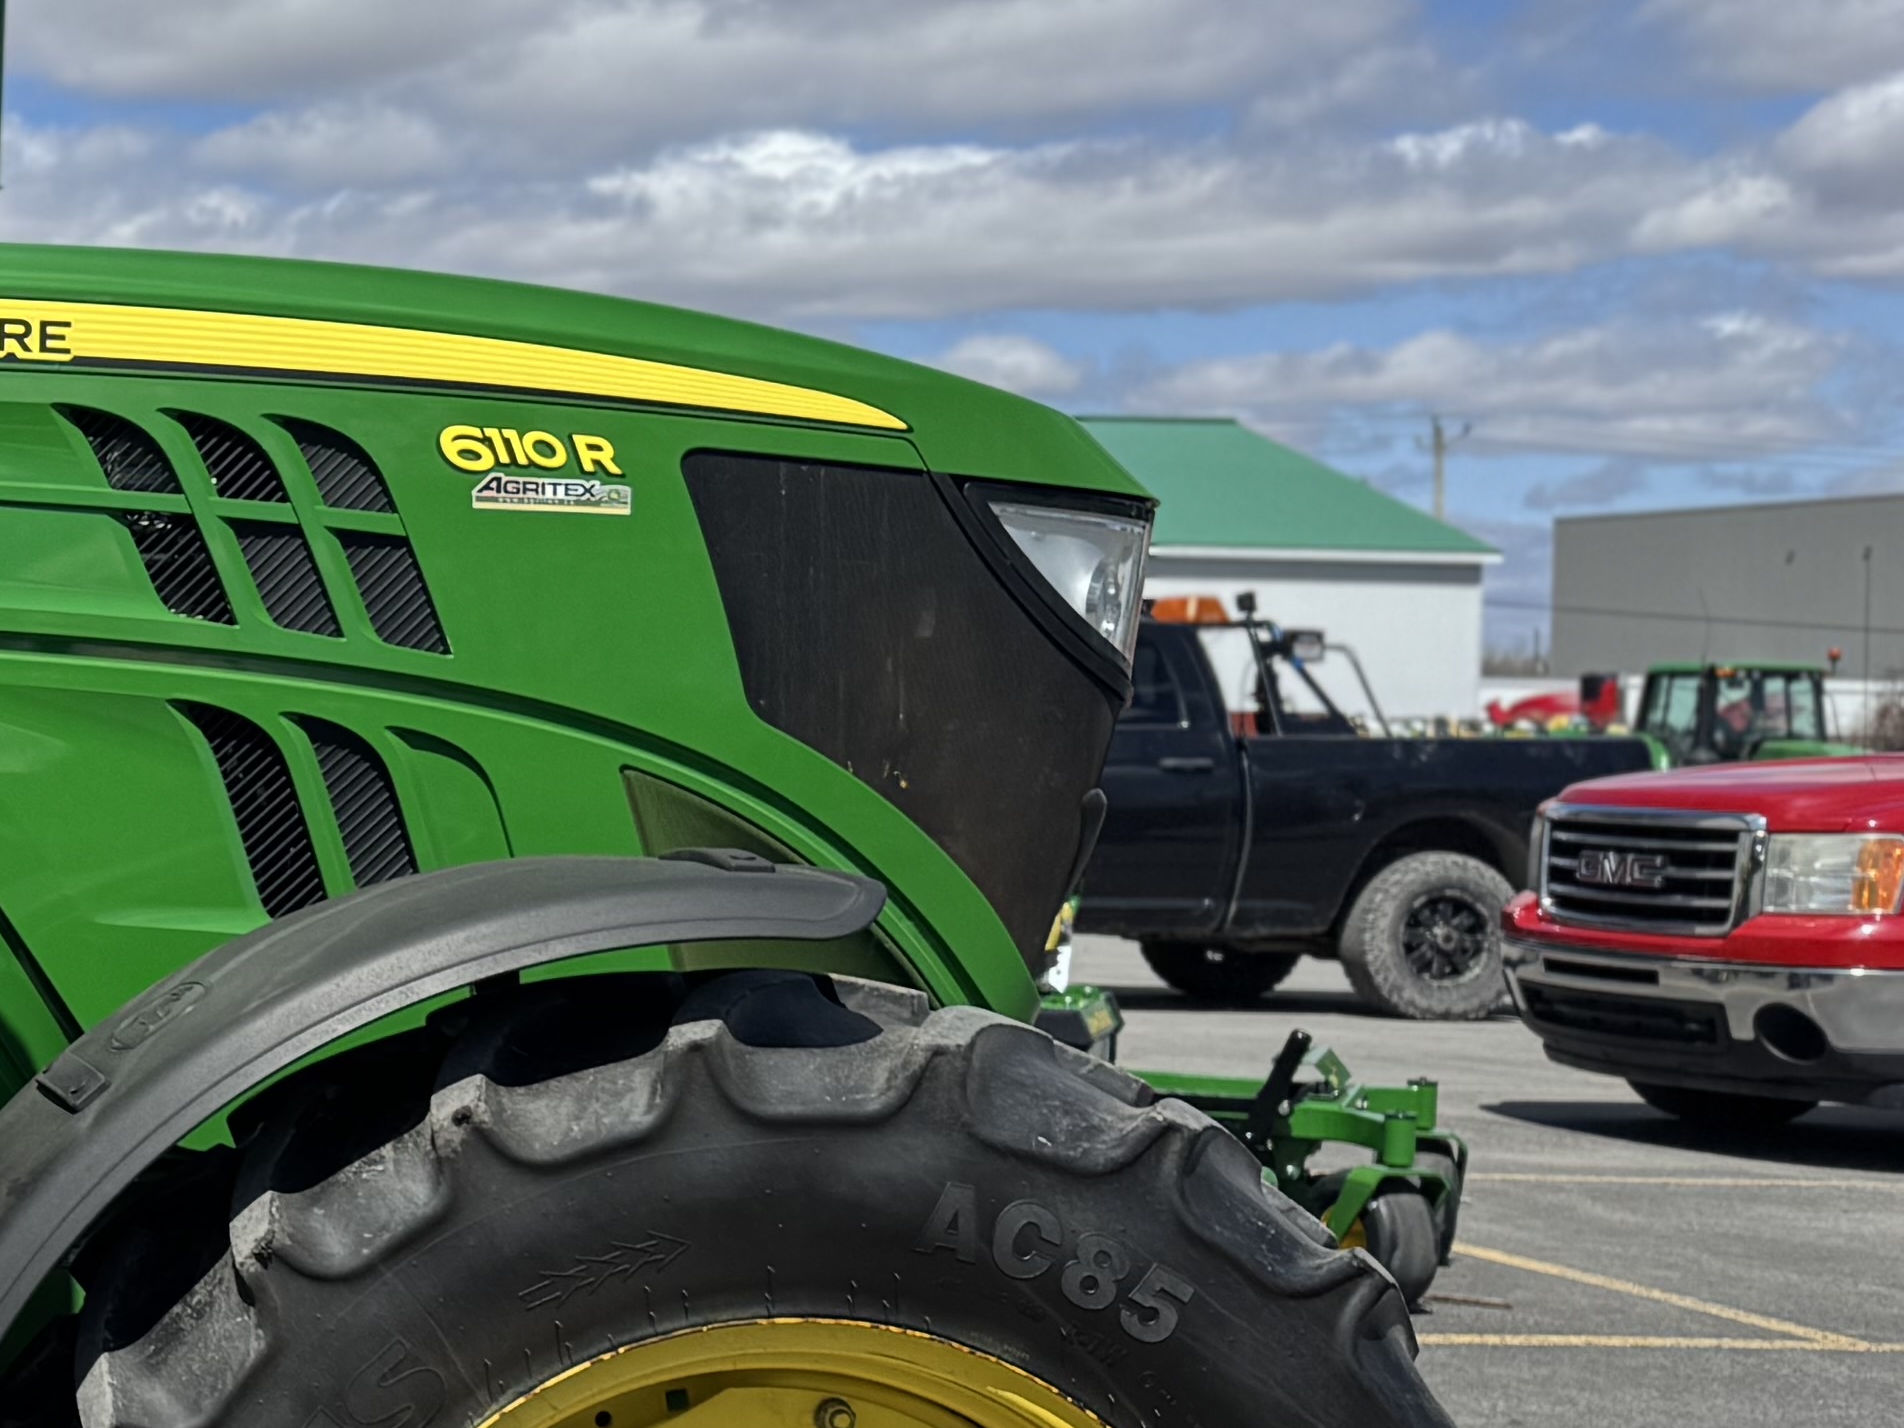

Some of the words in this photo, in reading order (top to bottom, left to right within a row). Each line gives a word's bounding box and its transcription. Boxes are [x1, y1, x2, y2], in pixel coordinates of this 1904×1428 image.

[439, 424, 568, 472] 6110
[571, 433, 623, 475] R
[476, 475, 597, 499] AGRITEX
[1576, 851, 1665, 888] GMC
[914, 1180, 1196, 1345] AC85
